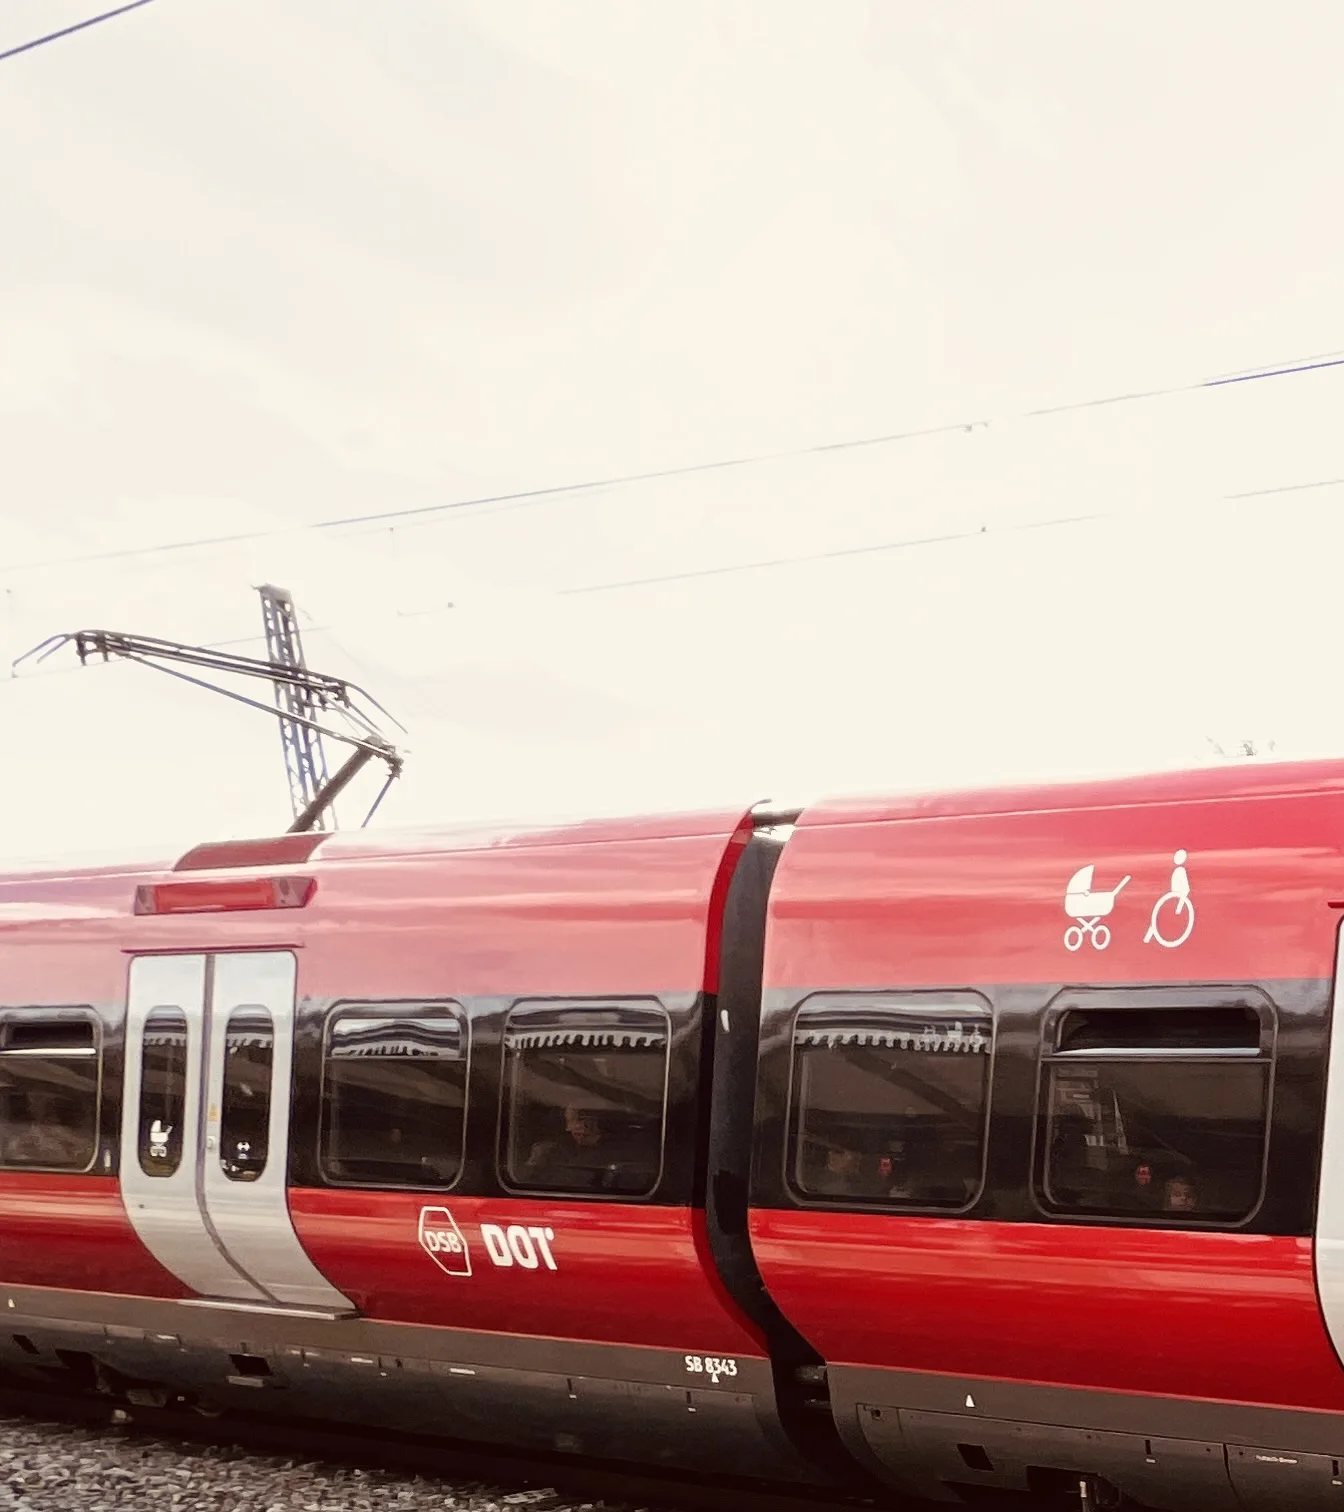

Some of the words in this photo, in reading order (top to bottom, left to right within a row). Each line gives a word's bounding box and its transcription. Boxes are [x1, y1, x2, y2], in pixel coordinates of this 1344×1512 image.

[425, 1231, 463, 1253] DSB
[685, 1355, 703, 1372] SB
[705, 1357, 738, 1376] 8343
